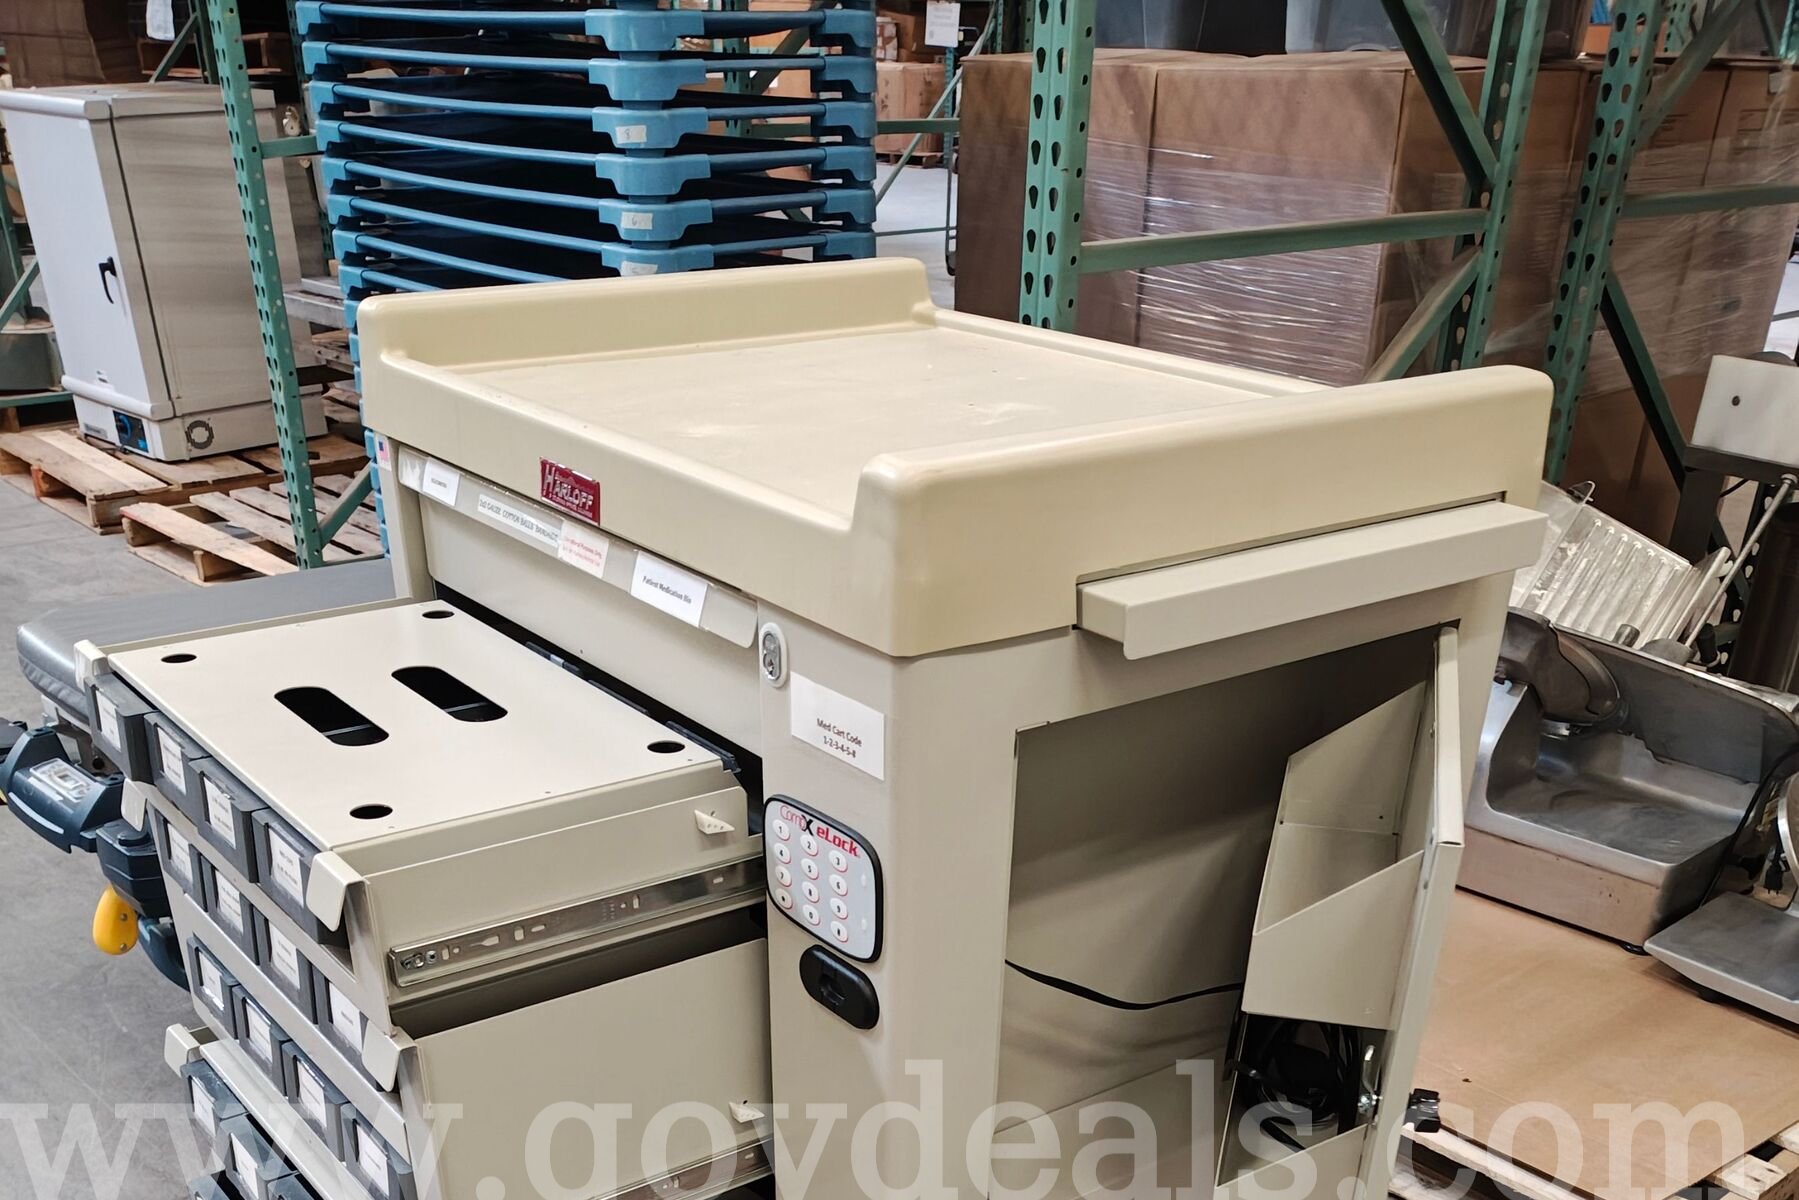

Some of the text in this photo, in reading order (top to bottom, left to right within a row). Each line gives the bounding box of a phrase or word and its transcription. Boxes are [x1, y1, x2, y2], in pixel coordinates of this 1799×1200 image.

[542, 464, 594, 510] HARLOFF
[659, 581, 683, 600] Medication
[816, 717, 862, 747] Med Cart Code
[816, 824, 859, 857] eLock
